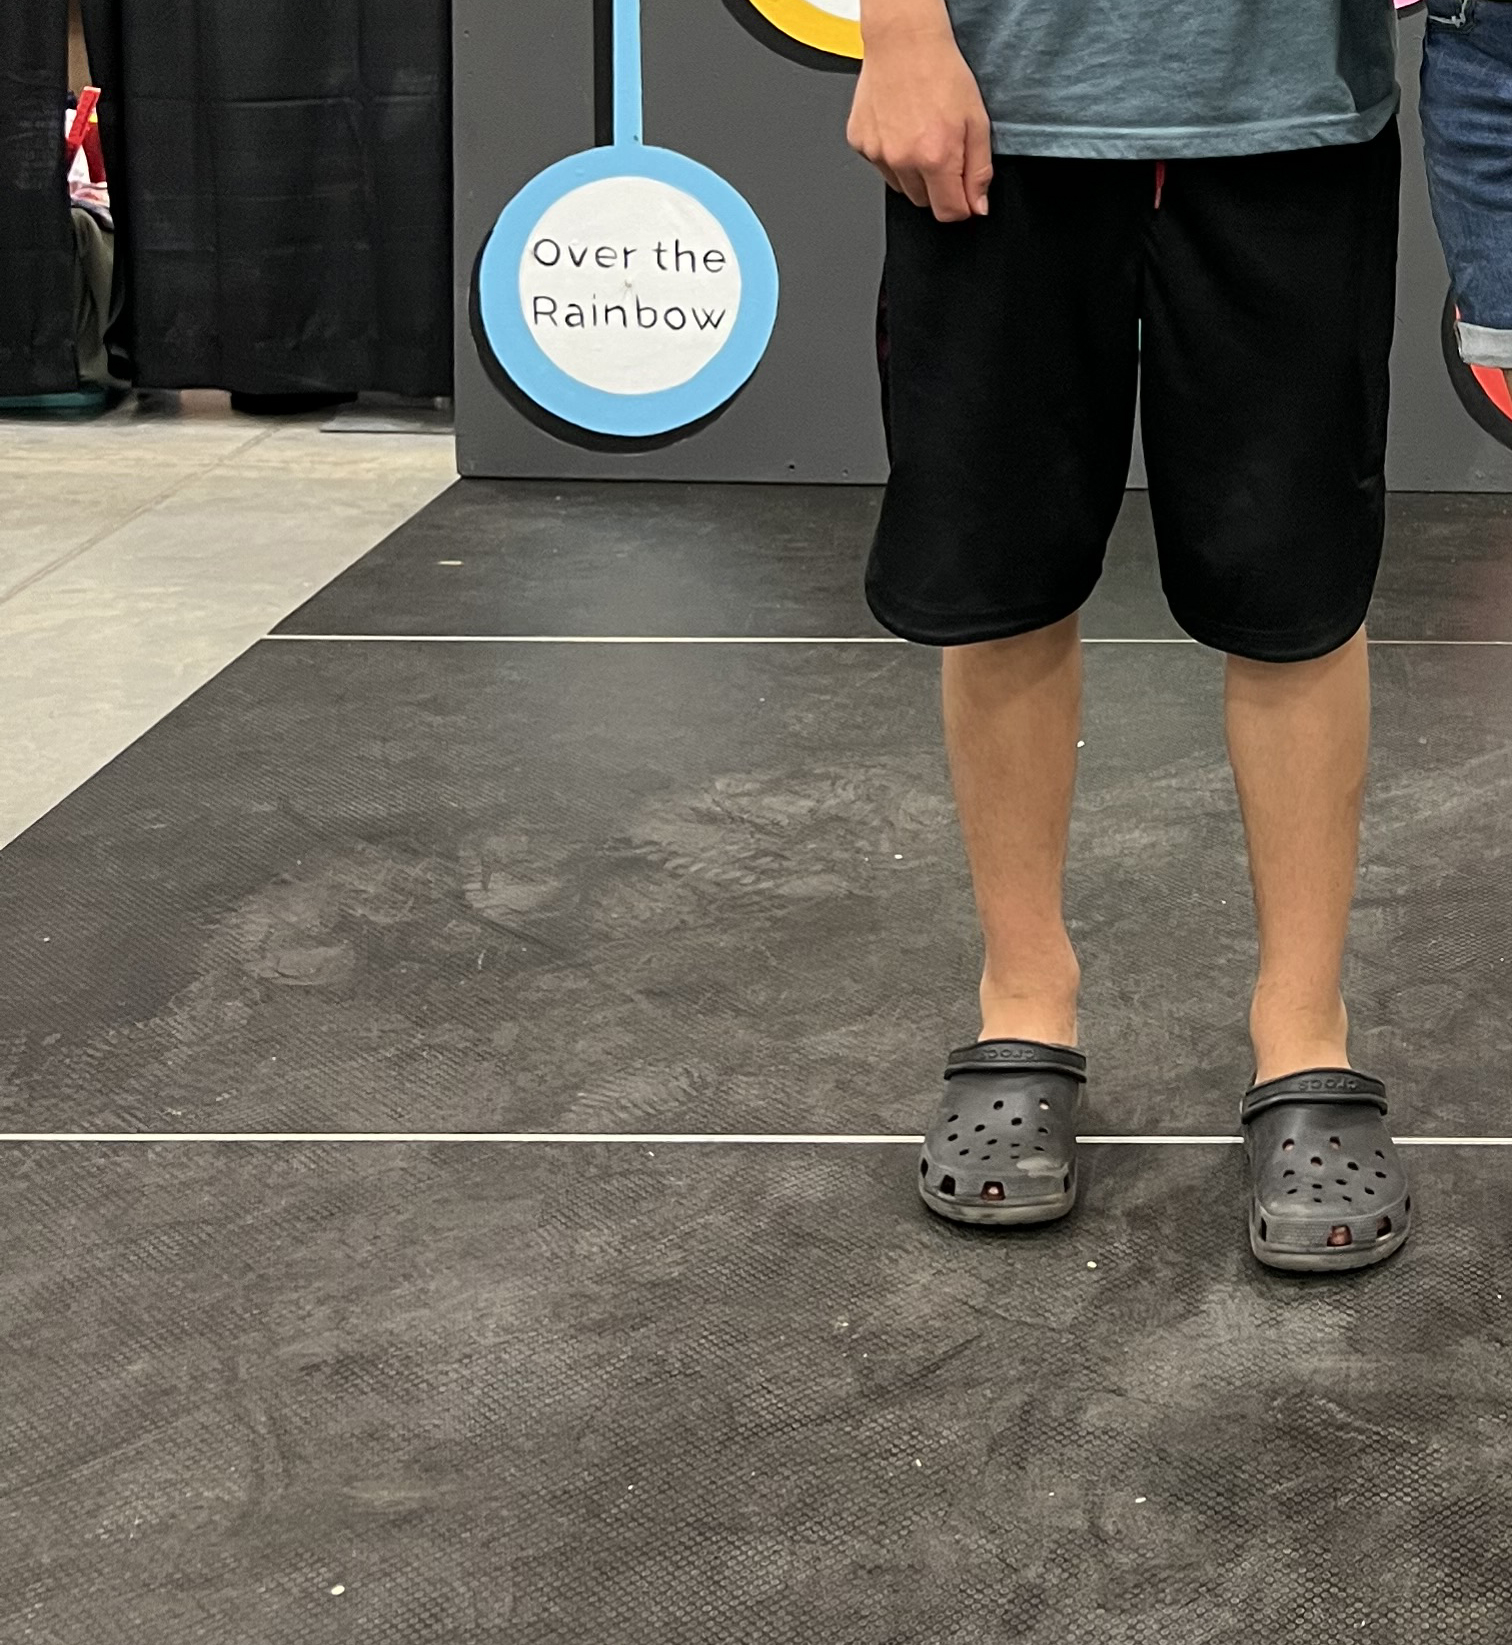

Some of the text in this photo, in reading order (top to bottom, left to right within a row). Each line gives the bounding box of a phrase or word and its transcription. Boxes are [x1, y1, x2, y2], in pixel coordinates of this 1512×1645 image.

[532, 238, 727, 273] Over the
[532, 293, 727, 331] Rainbow
